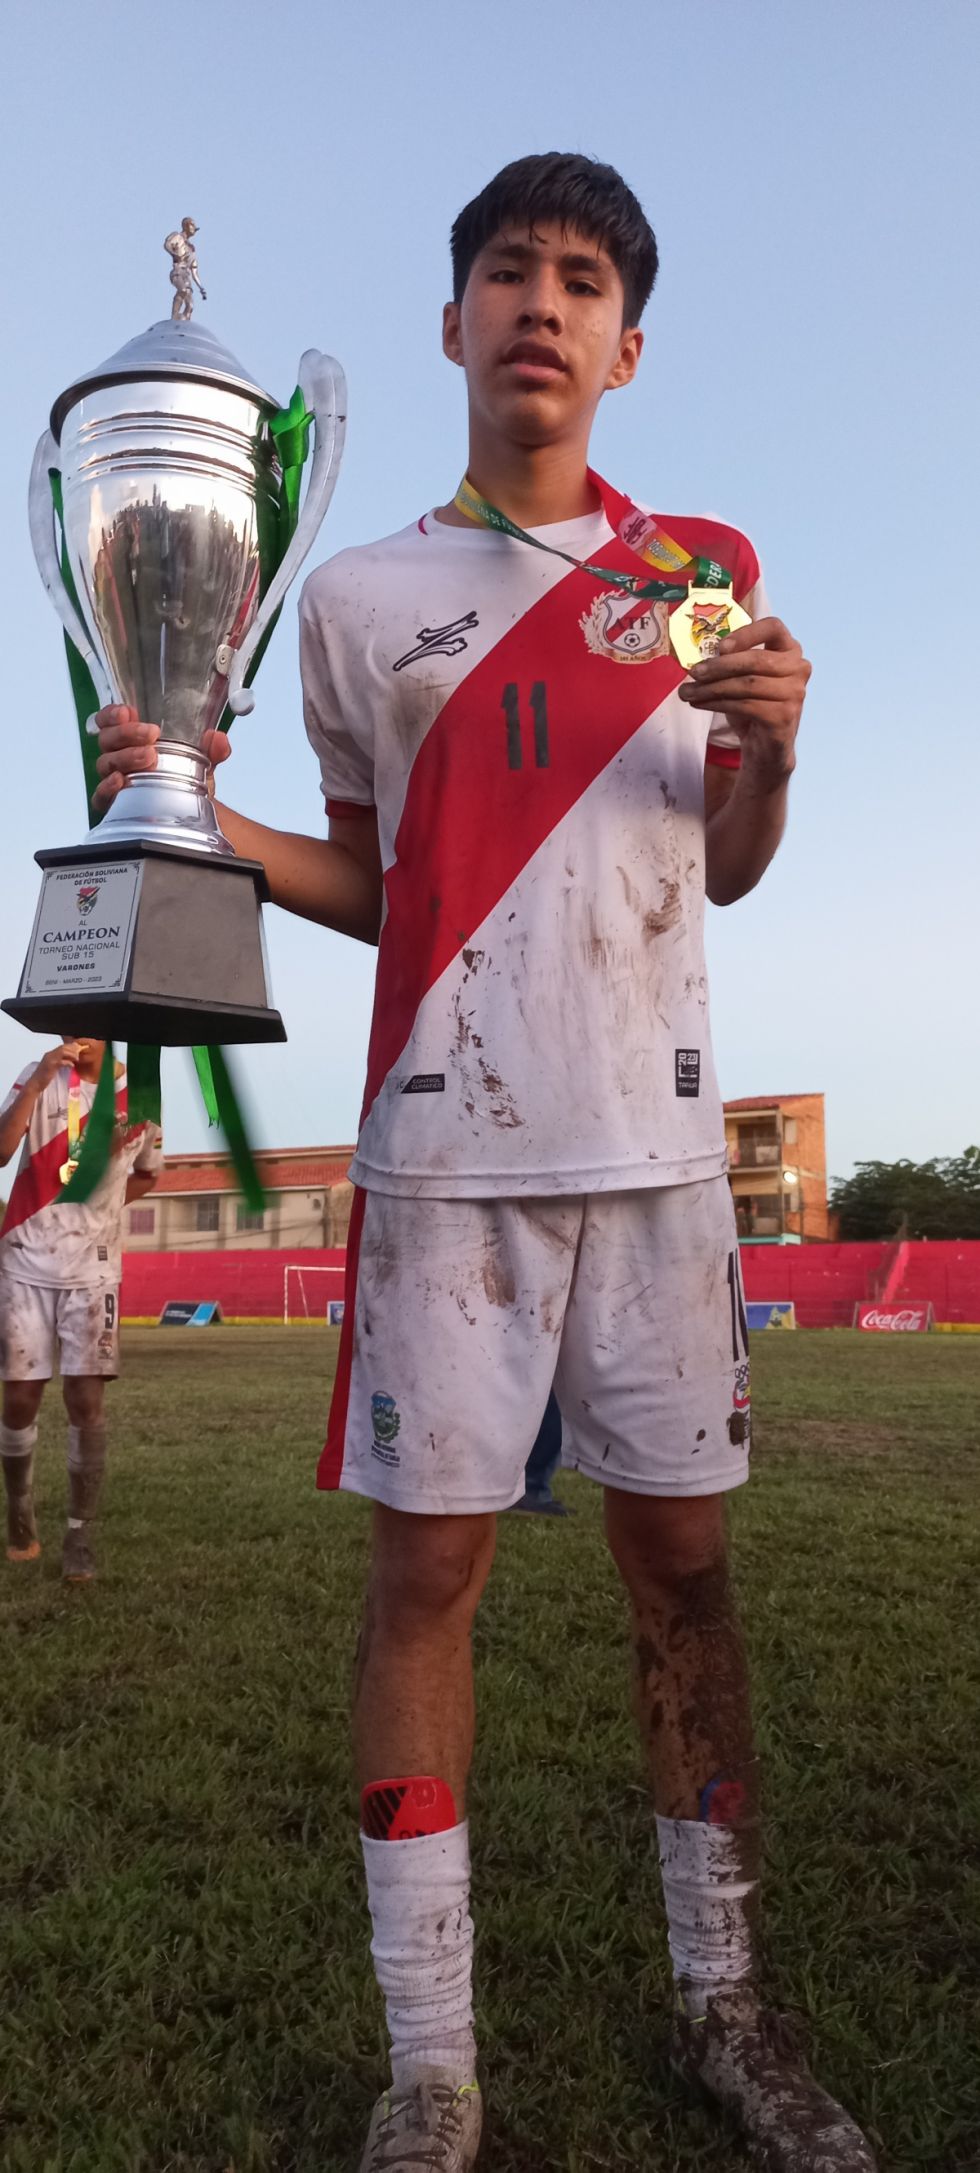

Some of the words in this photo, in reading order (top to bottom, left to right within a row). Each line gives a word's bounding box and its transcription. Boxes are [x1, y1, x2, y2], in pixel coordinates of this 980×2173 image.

[611, 616, 651, 630] ATF
[501, 681, 550, 770] 11
[56, 871, 94, 880] FEDERACIÓN
[95, 867, 128, 877] BOLIVIANA
[83, 877, 107, 885] FÚTBOL
[43, 926, 120, 944] CAMPEON
[39, 945, 73, 954] TORNEO
[76, 941, 120, 951] NACIONAL
[62, 952, 80, 960] SUB
[57, 963, 95, 972] VARONES
[105, 1293, 115, 1329] 9
